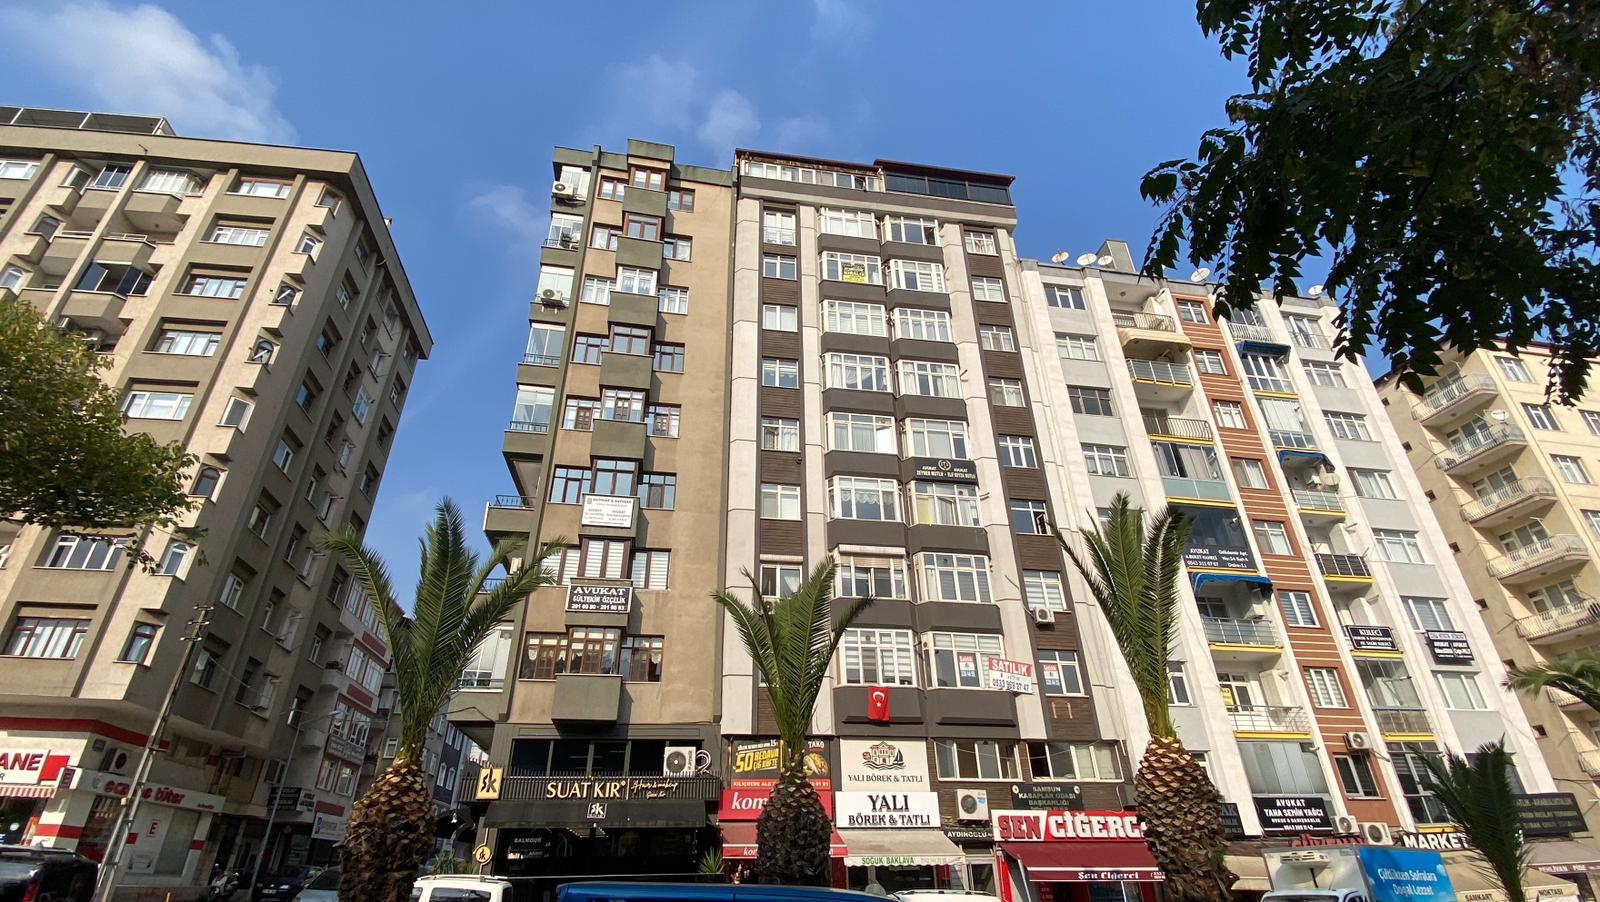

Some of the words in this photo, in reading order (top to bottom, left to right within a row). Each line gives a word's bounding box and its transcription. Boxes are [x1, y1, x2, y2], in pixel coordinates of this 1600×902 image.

[574, 586, 626, 596] AVUKAT
[573, 595, 600, 603] GÜLTEKİN
[602, 596, 626, 604] ÖZÇELİK
[992, 660, 1027, 676] SATILIK
[808, 741, 825, 749] TAKO
[754, 748, 779, 761] BEDAVA
[736, 752, 754, 773] 50
[866, 774, 892, 782] BÖREK
[546, 782, 591, 799] SUAT
[867, 794, 909, 812] YALI
[1276, 799, 1305, 807] AVUKAT
[1264, 808, 1283, 817] TAHA
[1303, 808, 1324, 817] YAĞCI
[848, 812, 886, 826] BÖREK
[889, 815, 897, 826] &
[899, 815, 930, 826] TATLI
[862, 857, 883, 865] SOĞUK
[1409, 869, 1438, 881] Sofralara
[1392, 884, 1412, 896] Doğal
[1413, 885, 1434, 896] Lezzet
